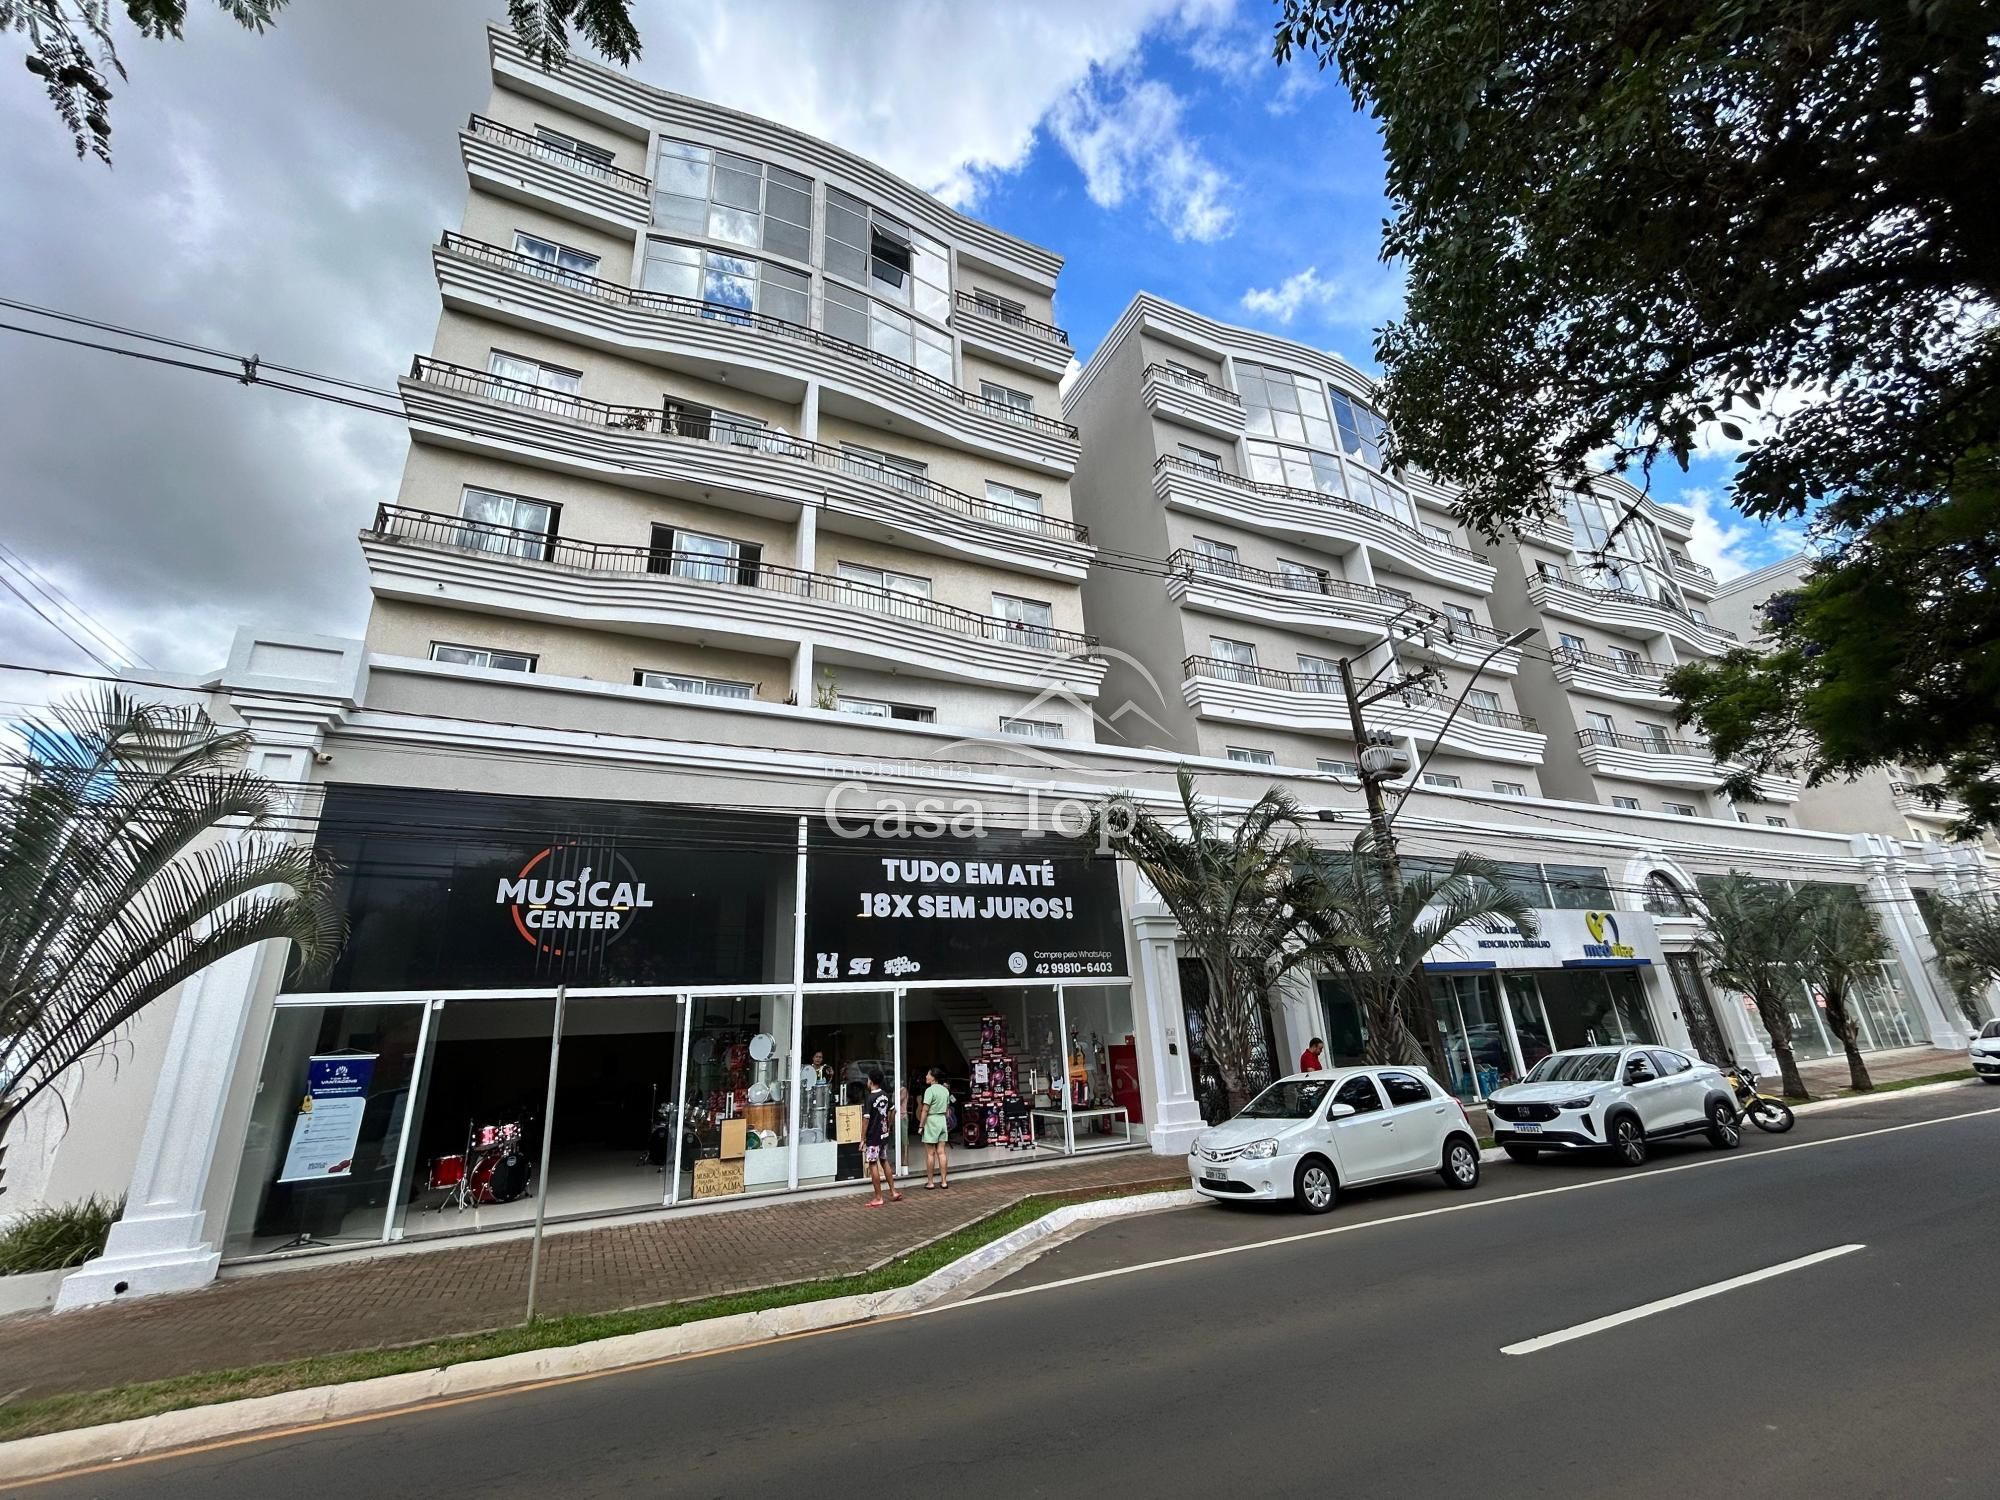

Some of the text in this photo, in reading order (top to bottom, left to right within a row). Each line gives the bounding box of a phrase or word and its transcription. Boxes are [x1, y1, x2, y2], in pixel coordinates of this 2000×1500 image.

[881, 858, 1055, 886] TUDO EM ATÉ
[496, 867, 654, 907] MUSICAL
[859, 892, 1074, 919] 18X SEM JUROS!
[525, 909, 621, 930] CENTER
[1509, 940, 1519, 949] DO
[1033, 950, 1112, 961] Compre pelo WhatsApp
[1035, 962, 1113, 974] 42 99810-6403
